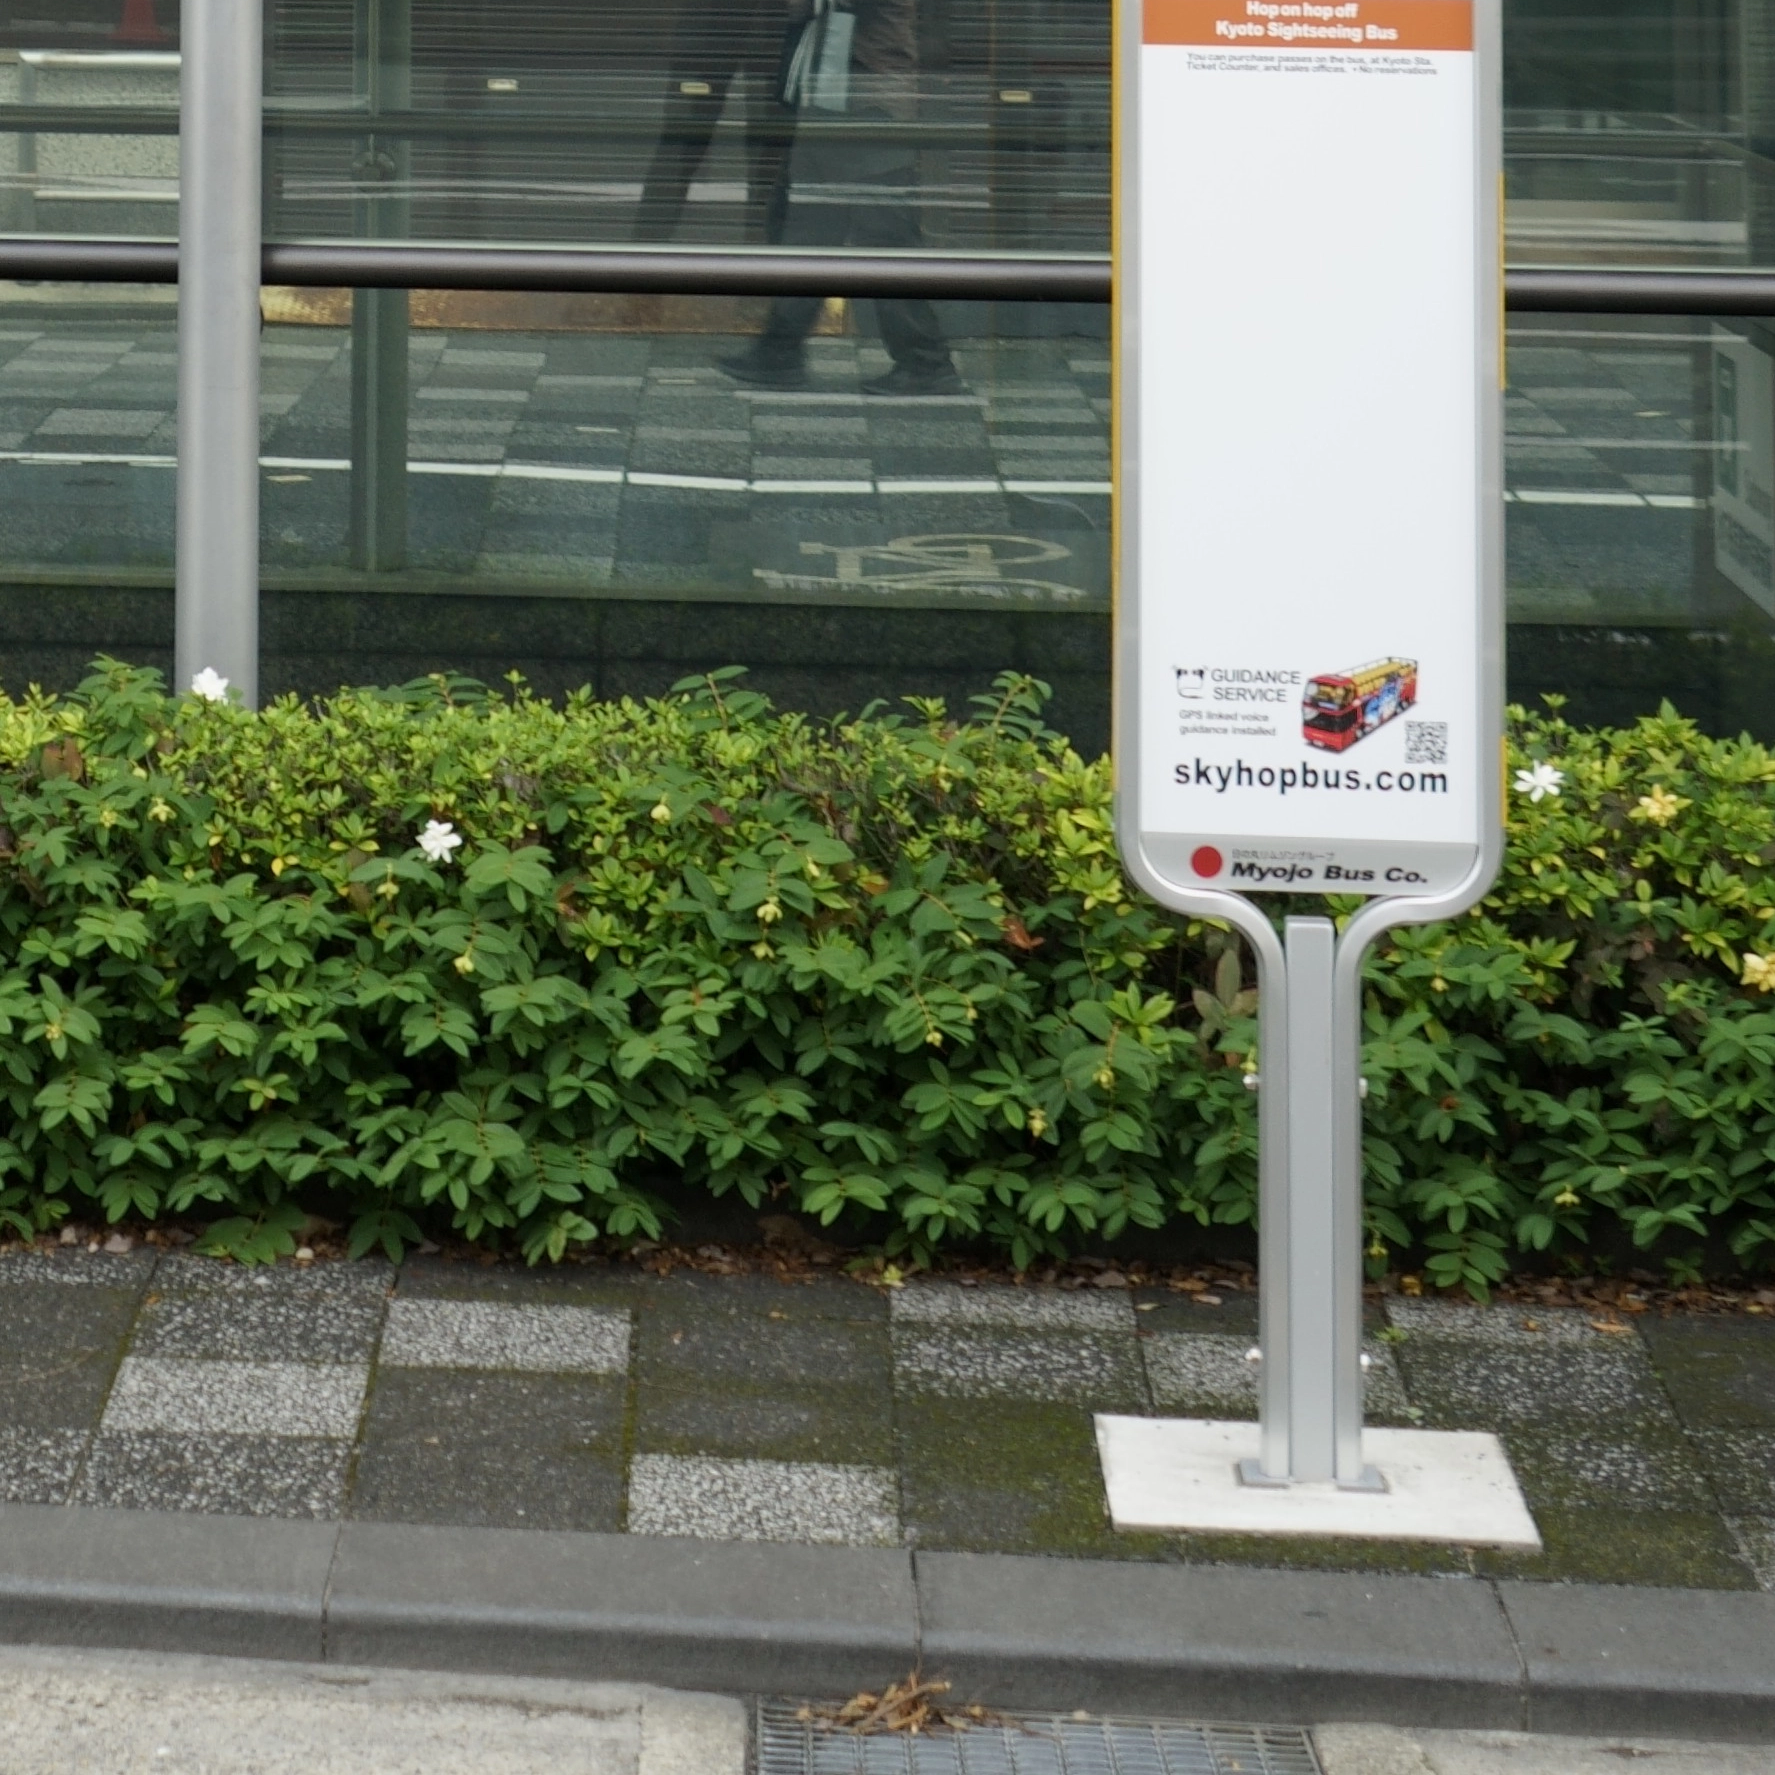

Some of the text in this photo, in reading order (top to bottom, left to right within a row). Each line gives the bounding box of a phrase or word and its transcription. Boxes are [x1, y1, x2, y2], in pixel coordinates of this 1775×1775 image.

[1246, 0, 1358, 20] Hop on hop off
[1216, 20, 1398, 42] Kyoto Sightseeing Bus
[1211, 668, 1301, 685] GUIDANCE
[1213, 687, 1288, 702] SERVICE
[1174, 758, 1448, 795] skyhopbus.com
[1231, 862, 1428, 883] Myojo Bus Co.
